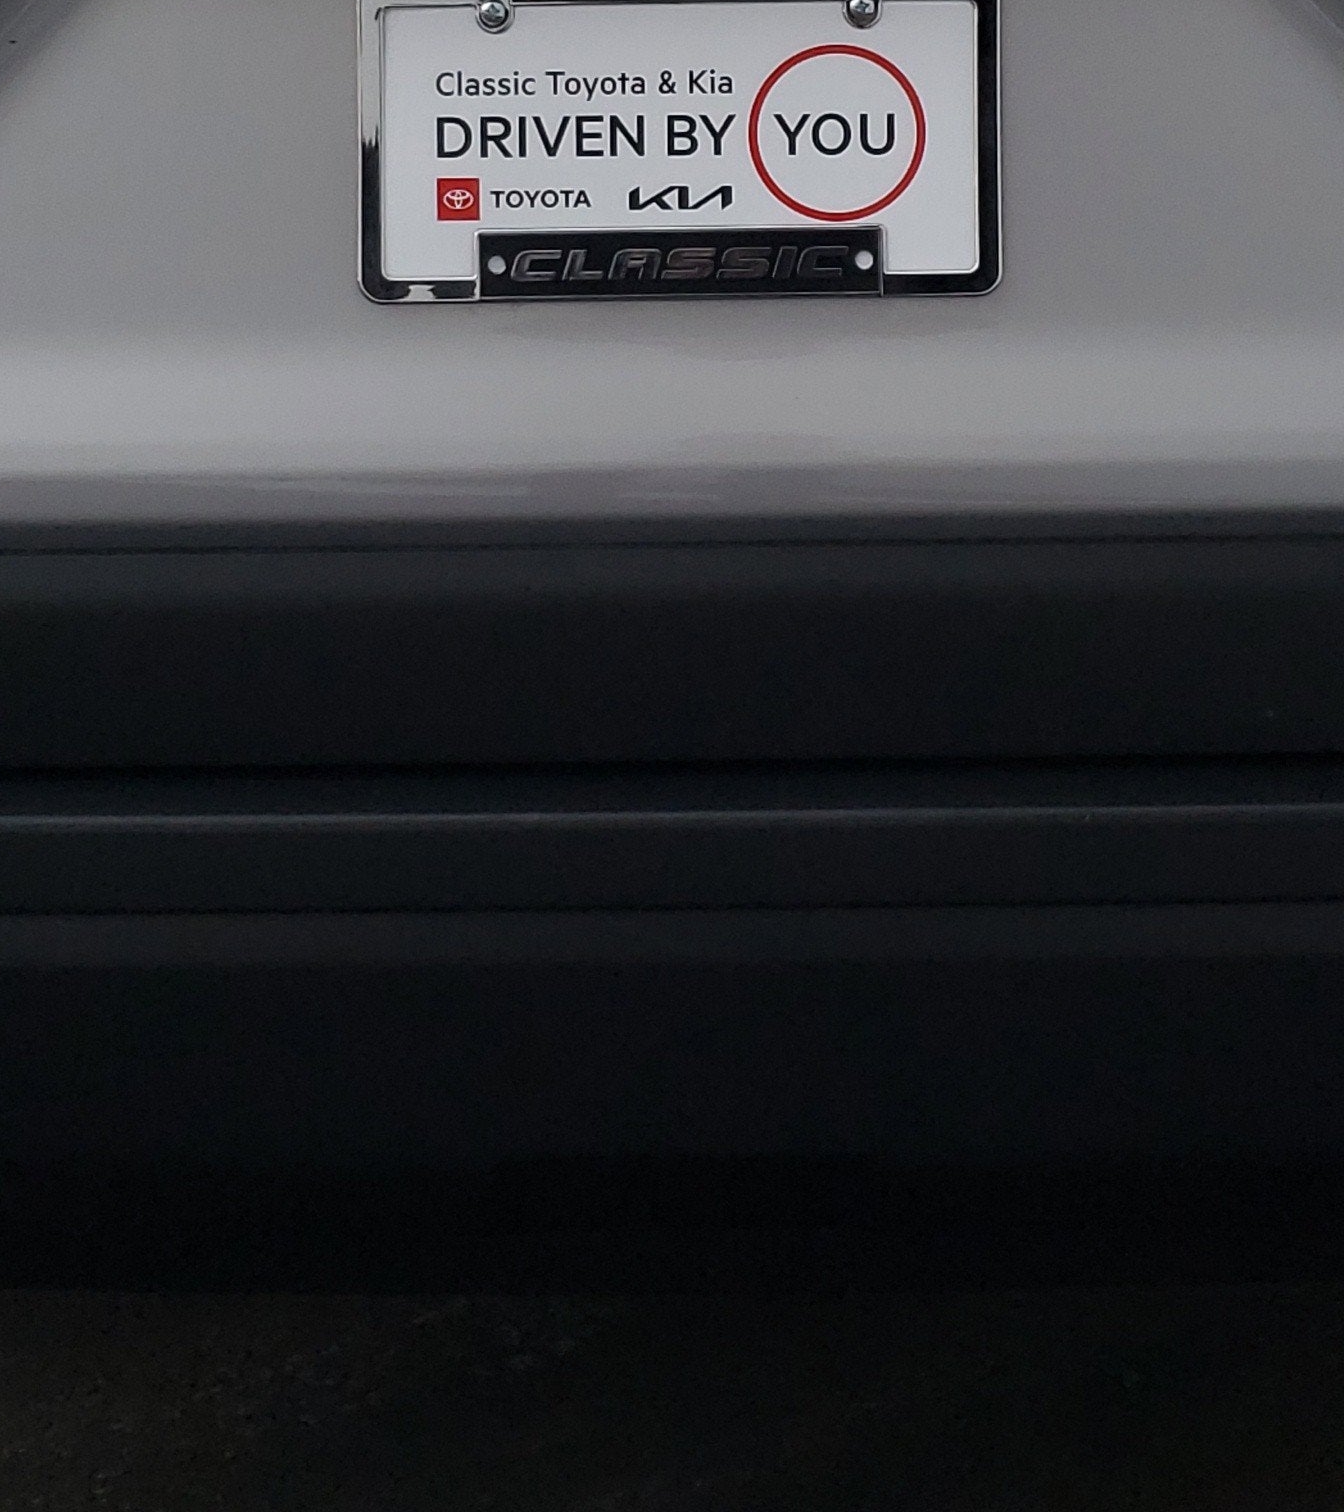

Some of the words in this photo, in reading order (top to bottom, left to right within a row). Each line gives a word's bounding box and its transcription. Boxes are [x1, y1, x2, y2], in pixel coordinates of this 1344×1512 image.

[436, 70, 536, 97] Classic
[545, 70, 646, 102] Toyota
[658, 70, 677, 95] &
[688, 69, 734, 95] Kia
[436, 114, 645, 158] DRIVEN
[666, 113, 736, 157] BY
[773, 113, 895, 156] YOU
[489, 189, 592, 209] TOYOTA
[510, 245, 850, 282] CLASSIC
